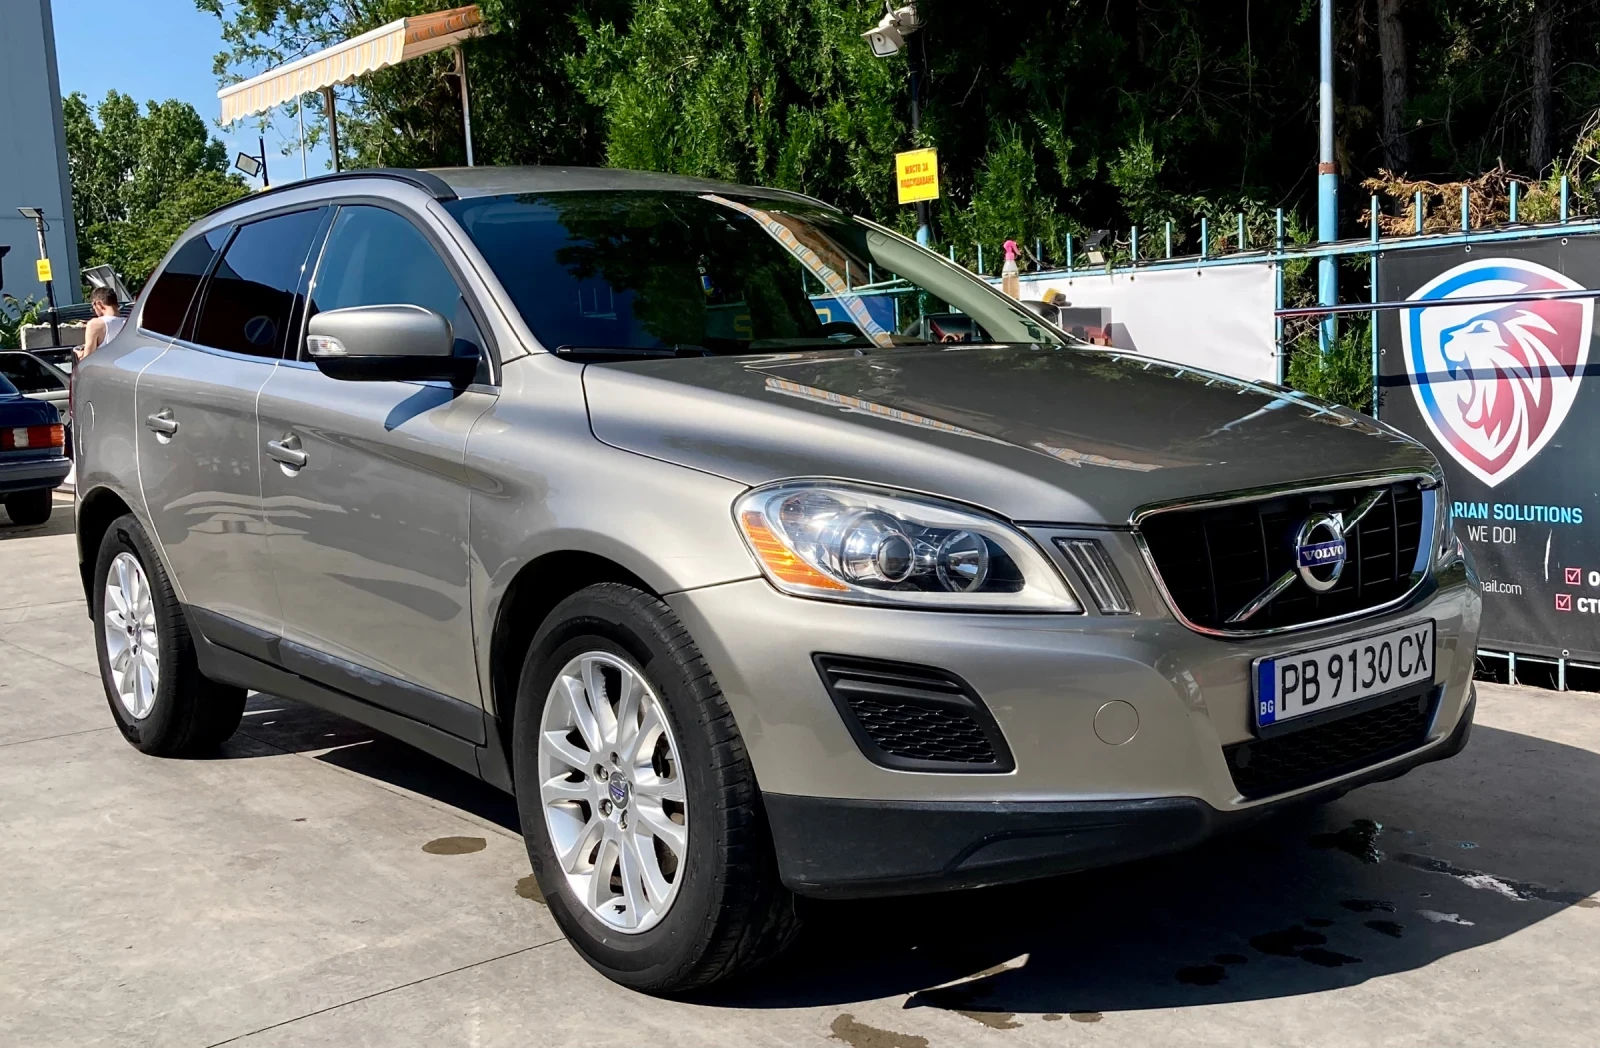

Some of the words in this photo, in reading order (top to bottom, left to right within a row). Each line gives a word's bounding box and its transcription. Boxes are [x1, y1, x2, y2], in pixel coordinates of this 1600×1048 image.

[1493, 503, 1583, 524] SOLUTIONS
[1467, 525, 1489, 543] WE
[1492, 526, 1517, 544] DO!
[1303, 546, 1344, 560] VOLVO
[1281, 659, 1320, 712] PB
[1327, 642, 1393, 699] 9130
[1398, 629, 1428, 679] CX
[1260, 700, 1274, 716] BG
